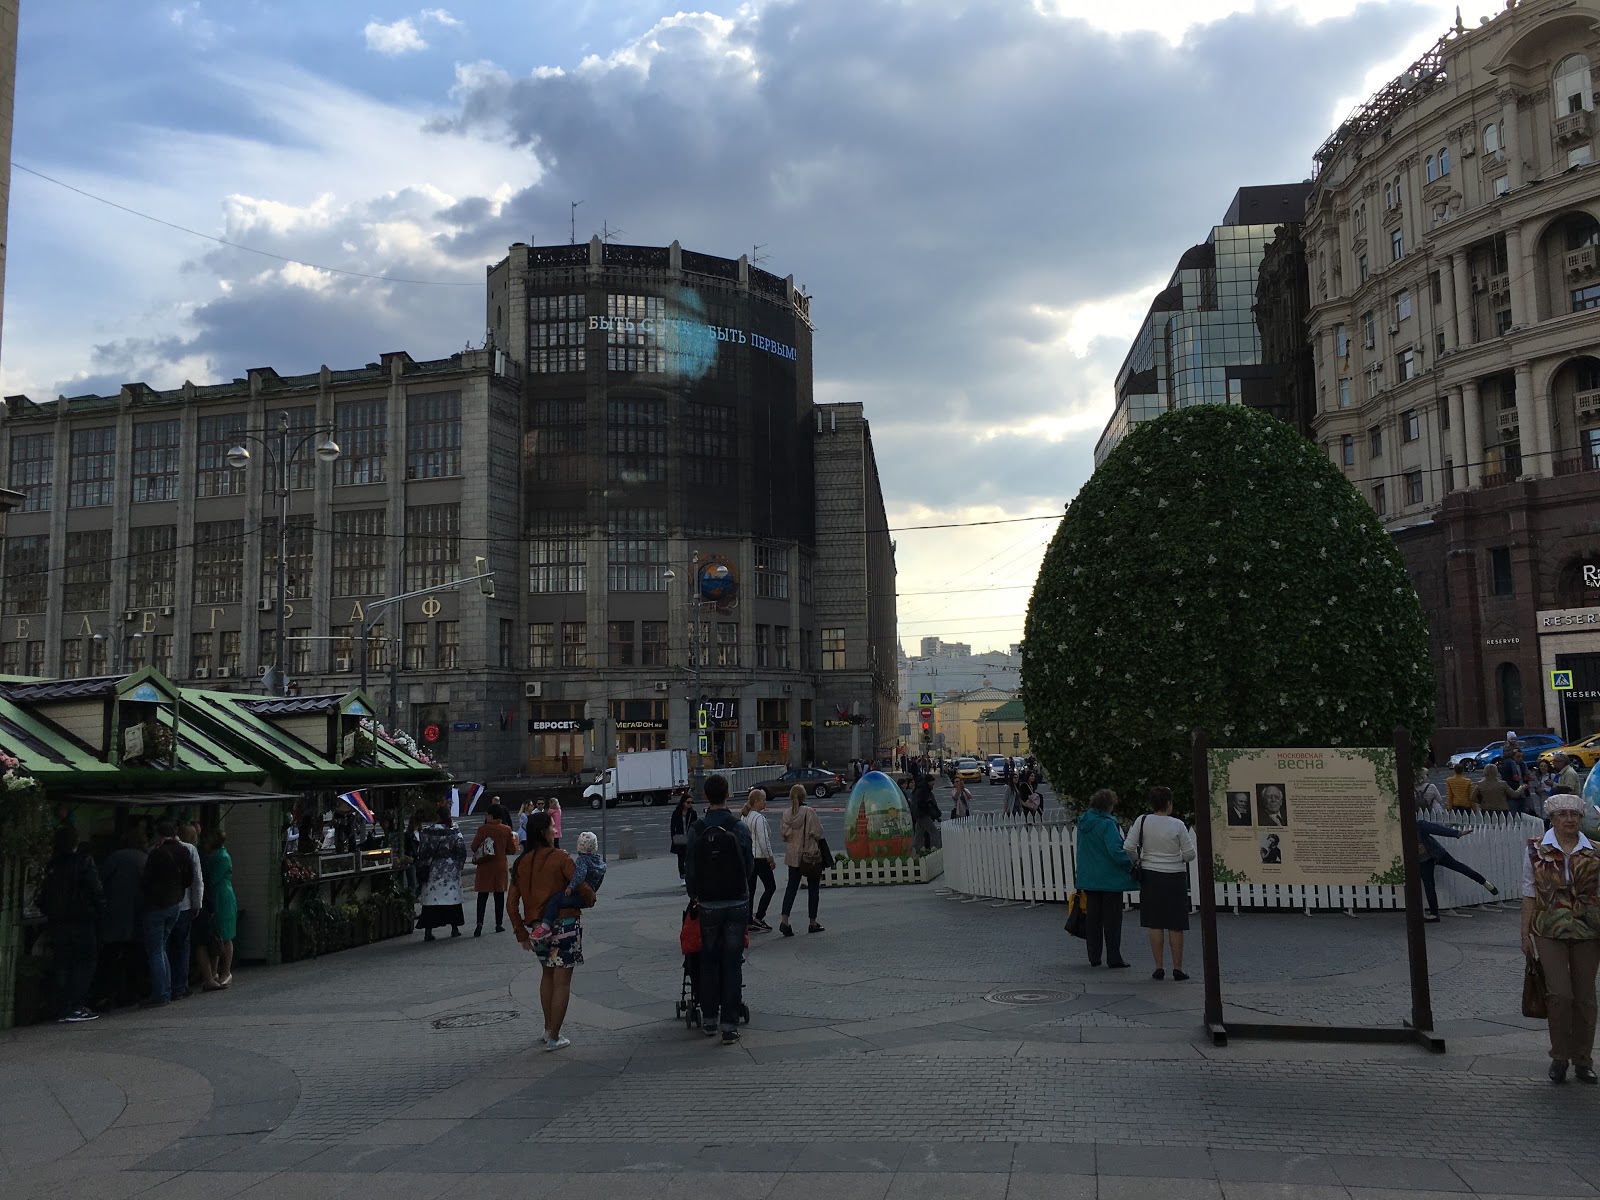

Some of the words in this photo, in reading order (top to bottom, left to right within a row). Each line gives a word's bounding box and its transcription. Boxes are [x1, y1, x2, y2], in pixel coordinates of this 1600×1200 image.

[589, 316, 635, 332] БЫТЬ
[641, 318, 654, 333] С
[708, 325, 747, 344] БЫТЬ
[750, 332, 797, 361] ПЕРВЫМ!
[1543, 613, 1600, 626] RESER
[1486, 637, 1520, 645] RESERVED
[720, 719, 738, 728] TELE2
[1277, 759, 1324, 770] весна
